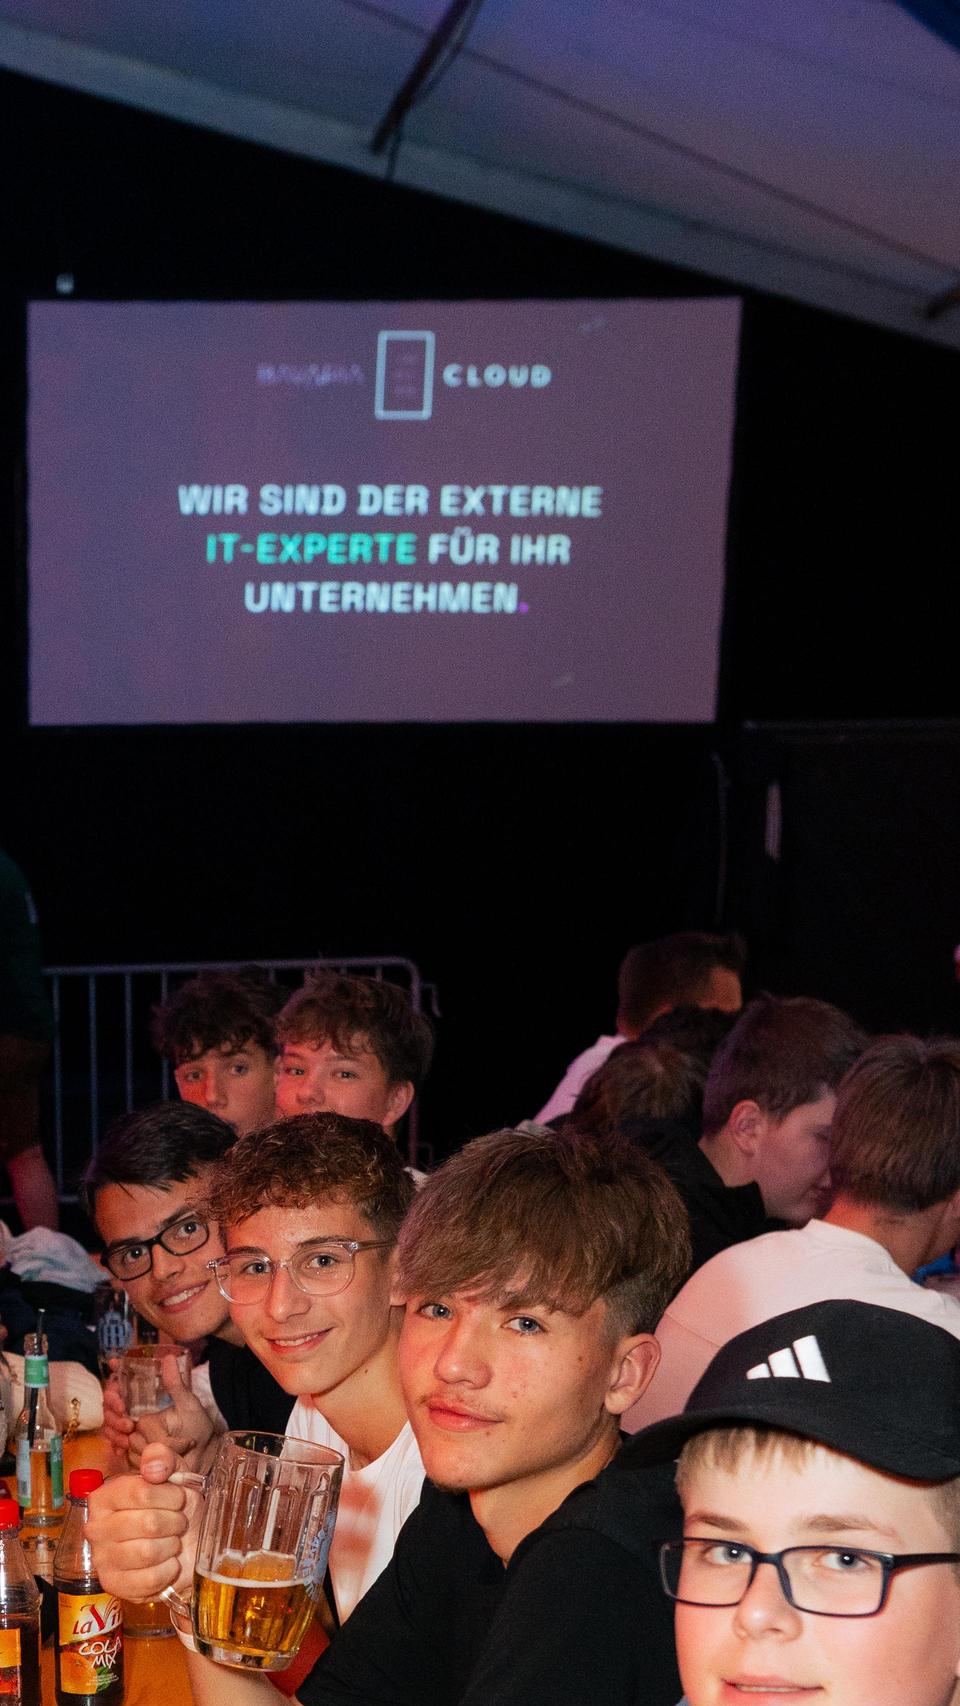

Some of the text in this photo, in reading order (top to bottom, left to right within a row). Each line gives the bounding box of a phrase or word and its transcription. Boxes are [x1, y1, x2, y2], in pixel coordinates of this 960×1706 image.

[442, 363, 552, 388] CLOUD
[177, 484, 604, 518] WIR SIND DER EXTERNE
[205, 526, 572, 566] IT-EXPERTE FÜR IHR
[243, 581, 529, 614] UNTERNEHMEN.
[78, 1636, 122, 1656] COLA
[91, 1652, 116, 1670] MIX
